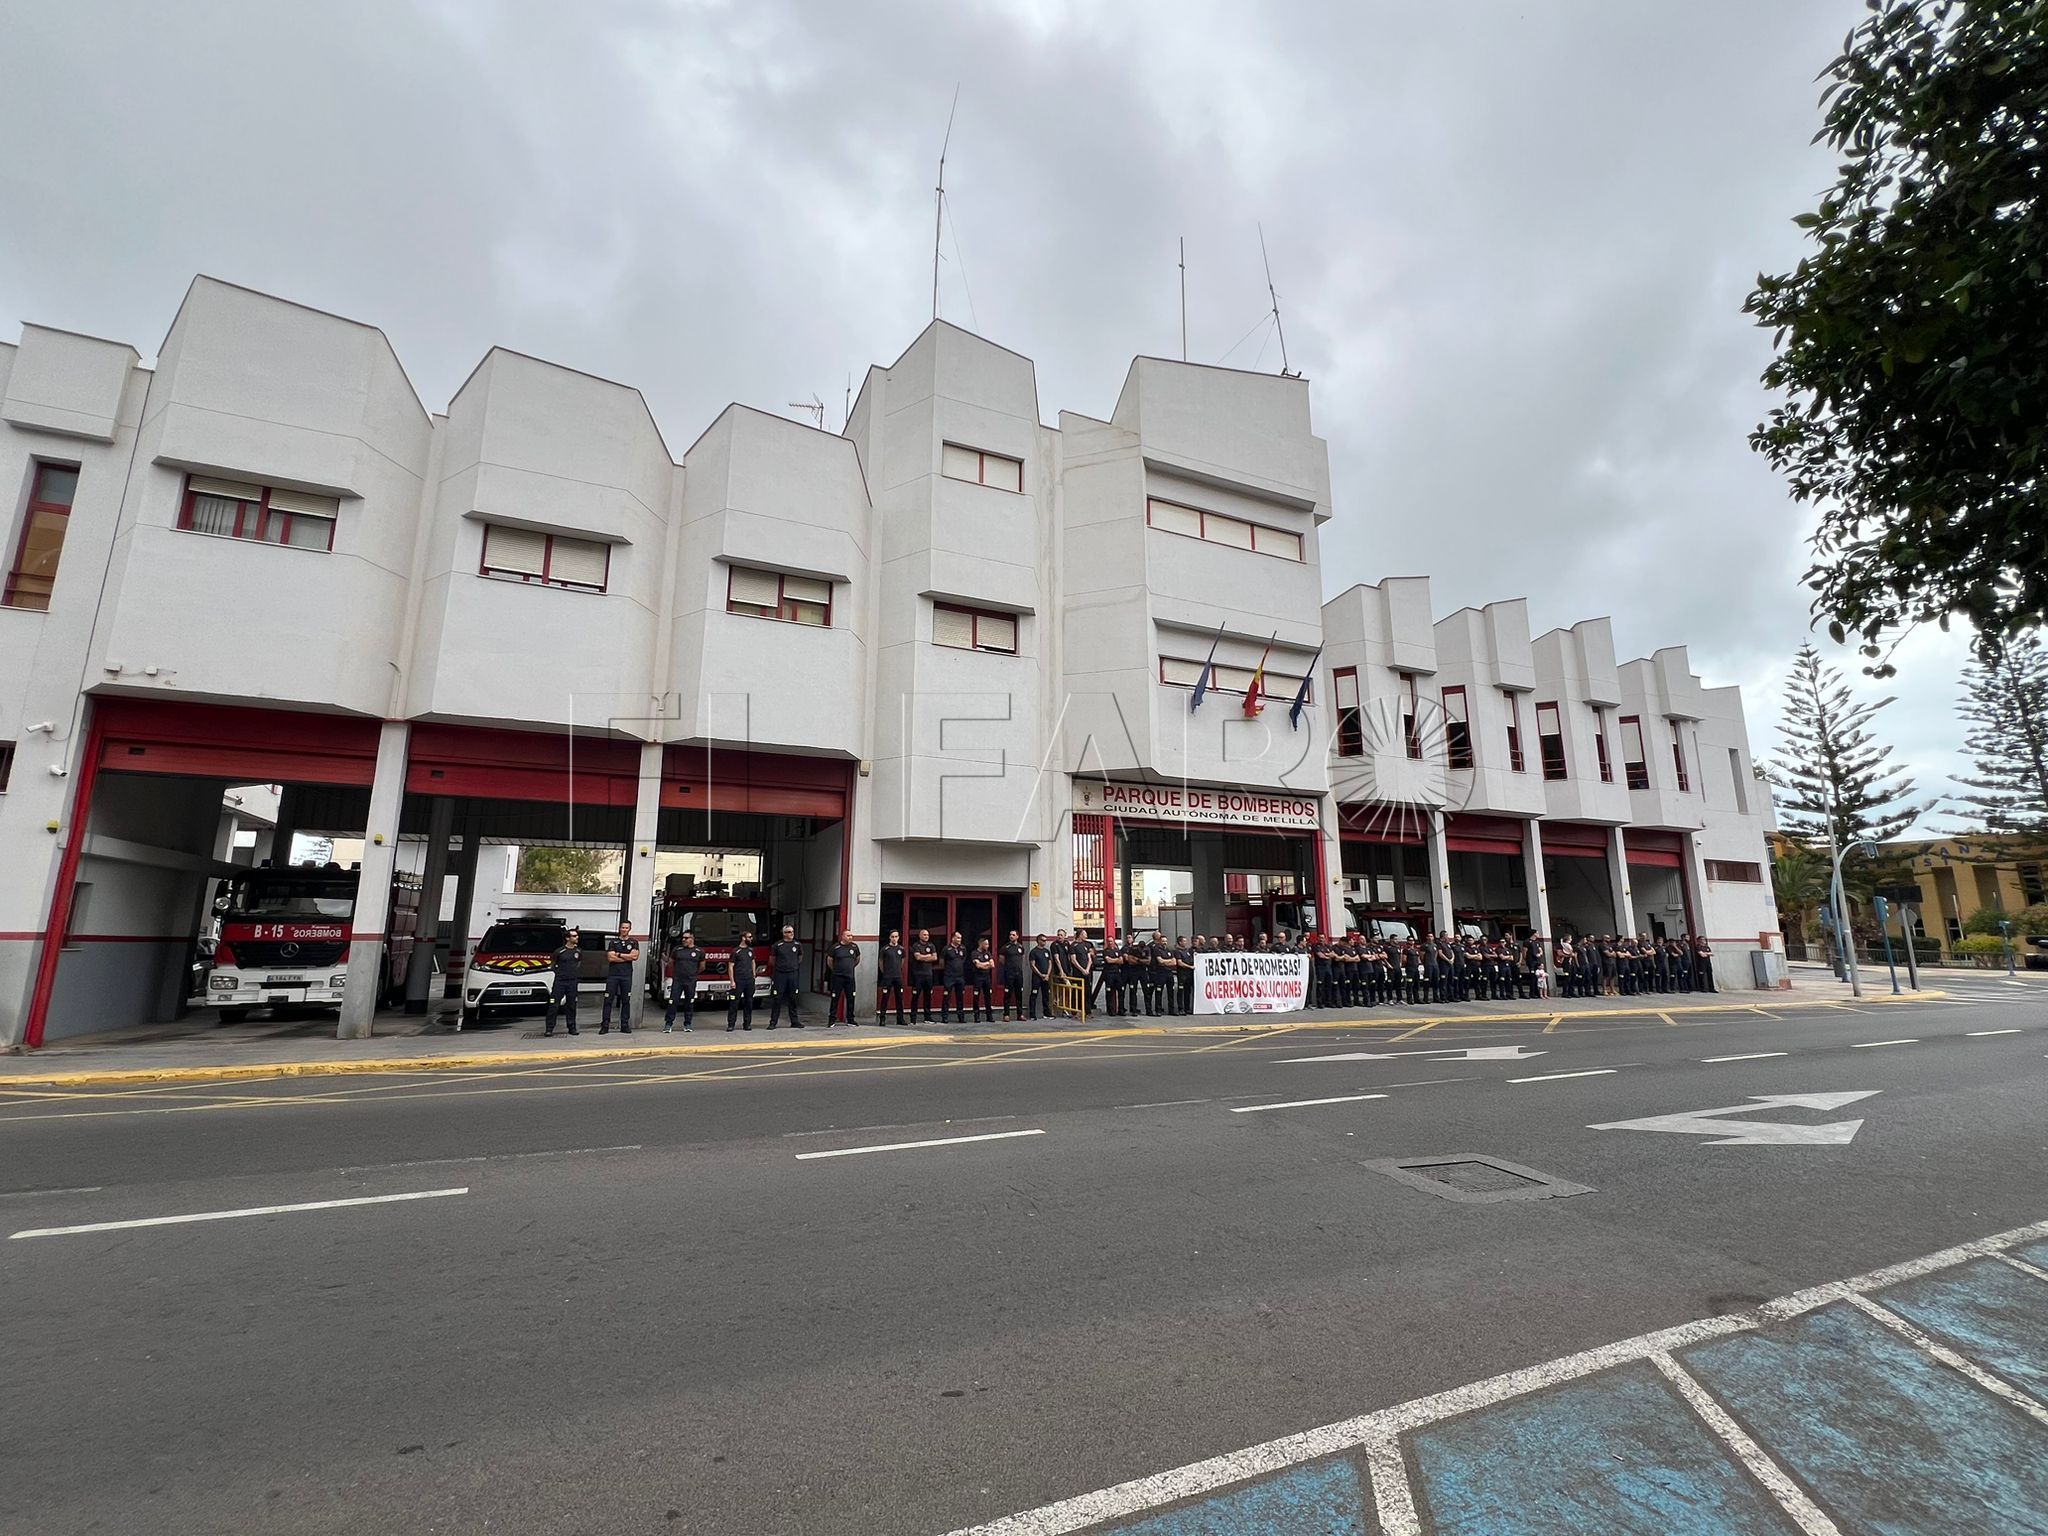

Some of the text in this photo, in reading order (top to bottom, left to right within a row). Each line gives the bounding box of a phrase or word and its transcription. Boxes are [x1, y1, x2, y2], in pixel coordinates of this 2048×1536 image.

[1103, 785, 1316, 817] PARQUE DE BOMBEROS
[1103, 804, 1316, 826] CIUDAD AUTÓNOMA DE MELILLA
[271, 924, 284, 938] 15
[1204, 958, 1301, 977] ¡BASTA DE PROMESAS!
[1205, 980, 1302, 999] QUEREMOS SOLUCIONES
